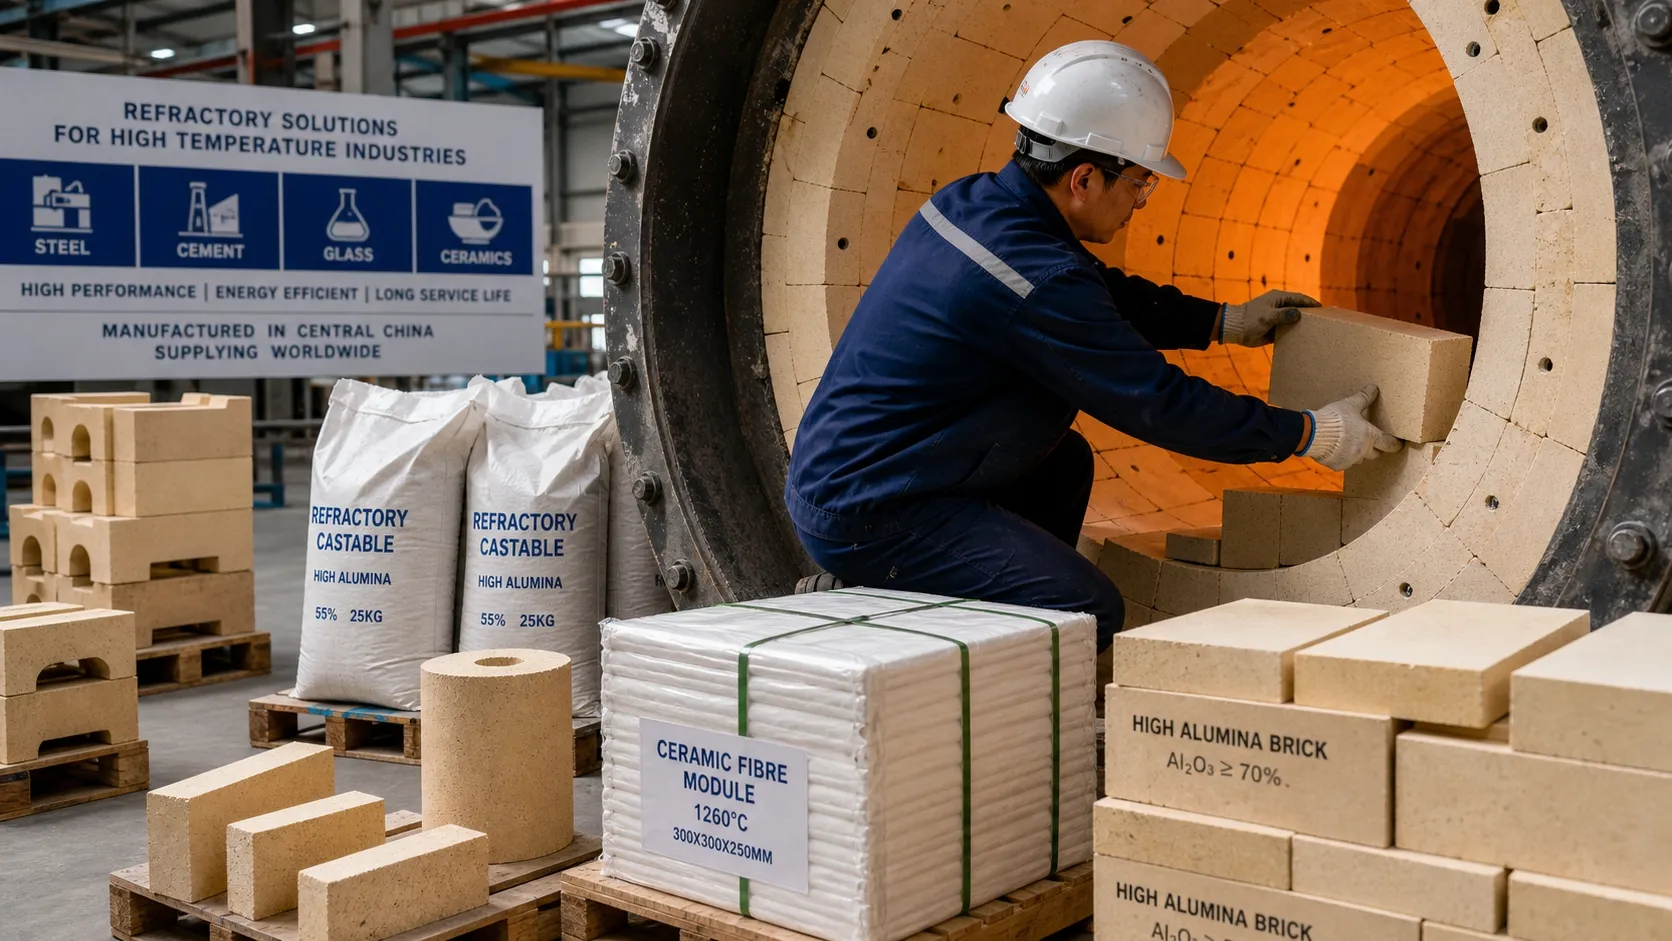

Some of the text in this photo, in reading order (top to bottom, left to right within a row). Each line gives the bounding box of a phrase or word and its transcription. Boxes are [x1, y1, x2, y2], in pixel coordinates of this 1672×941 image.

[124, 102, 398, 136] REFRACTORY SOLUTIONS
[54, 125, 466, 165] FOR HIGH TEMPERATURE INDUSTRIES
[35, 238, 91, 256] STEEL
[177, 242, 244, 259] CEMENT
[323, 246, 374, 262] GLASS
[441, 249, 512, 266] CERAMICS
[21, 282, 66, 298] HIGH
[71, 283, 196, 299] PERFORMANCE
[216, 284, 278, 300] ENERGY
[283, 285, 358, 300] EFFICIENT
[376, 287, 415, 301] LONG
[420, 287, 478, 302] SERVICE
[483, 288, 511, 302] LIFE
[102, 323, 434, 338] MANUFACTURED IN CENTRAL CHINA
[155, 345, 381, 360] SUPPLYING WORLDWIDE
[312, 506, 407, 527] REFRACTORY
[473, 512, 577, 531] REFRACTORY
[317, 533, 394, 553] CASTABLE
[480, 538, 563, 556] CASTABLE
[314, 570, 391, 586] HIGH ALUMINA
[478, 575, 562, 589] HIGH ALUMINA
[315, 607, 382, 623] 55% 25KG
[480, 613, 555, 627] 55% 25KG
[1133, 715, 1328, 760] HIGH ALUMINA BRICK
[657, 740, 787, 784] CERAMIC FIBRE
[684, 771, 755, 804] MODULE
[695, 804, 748, 832] 1260°C
[673, 827, 772, 865] 300X300X250MM
[1116, 882, 1313, 941] HIGH ALUMINA BRICK
